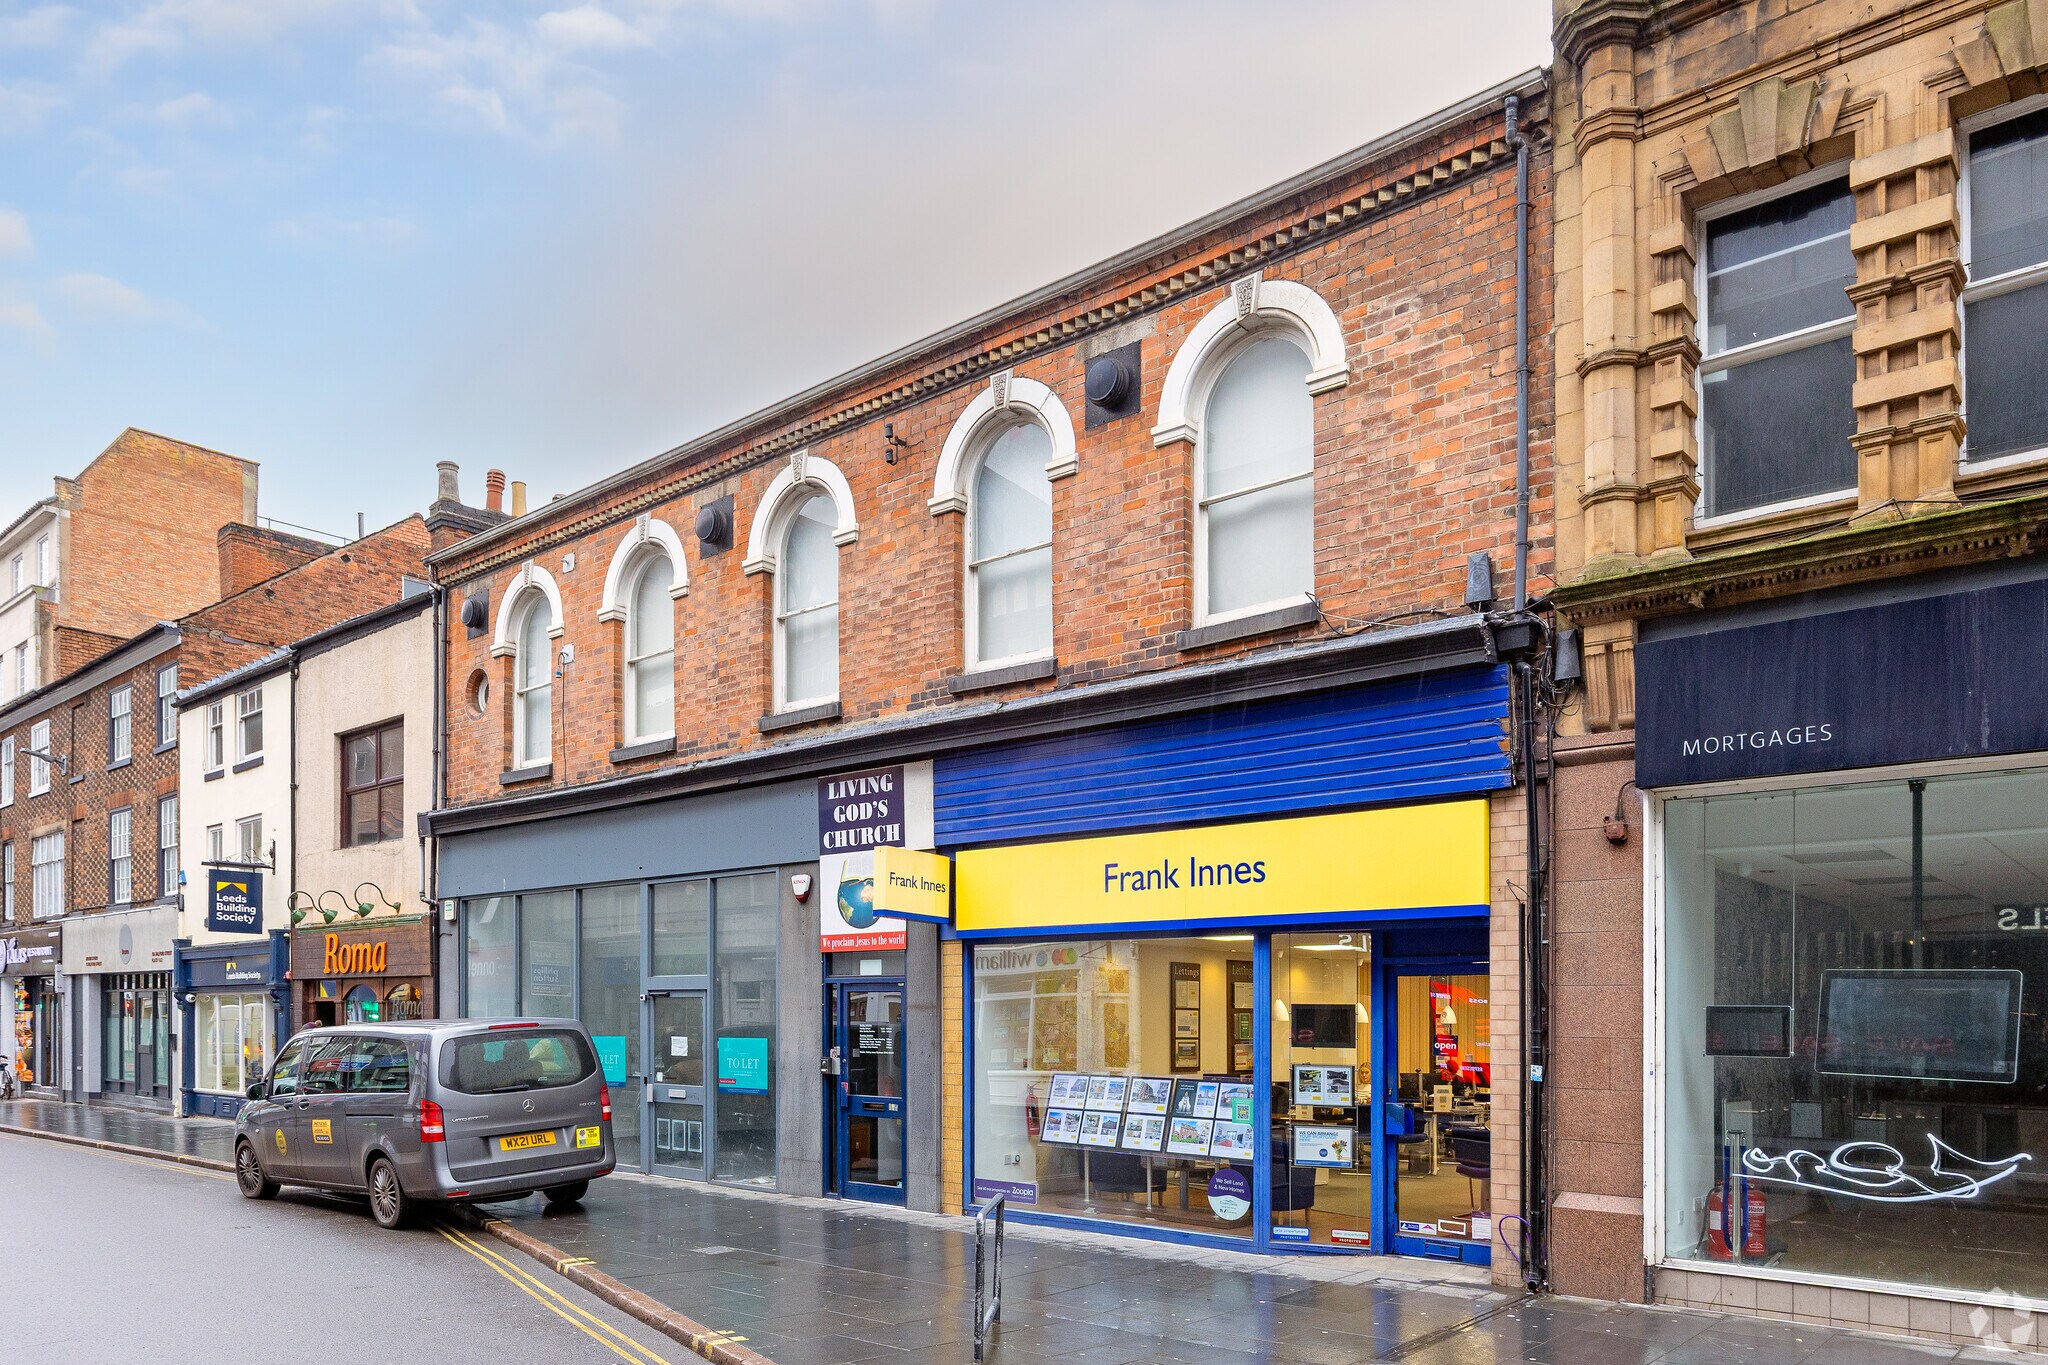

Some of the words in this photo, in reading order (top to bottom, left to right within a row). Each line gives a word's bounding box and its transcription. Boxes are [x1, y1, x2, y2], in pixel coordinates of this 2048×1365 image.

[1682, 723, 1832, 757] MORTGAGES
[827, 773, 894, 800] LIVING
[833, 799, 888, 824] GOD'S
[823, 823, 901, 849] CHURCH
[1104, 858, 1180, 893] Frank
[1190, 856, 1267, 887] Innes
[889, 871, 918, 889] Frank
[920, 876, 946, 893] Innes
[216, 892, 247, 904] Leeds
[216, 902, 257, 915] Building
[216, 911, 255, 924] Society
[822, 937, 830, 948] We
[832, 936, 854, 949] proclaim
[855, 936, 870, 947] Jesus
[871, 936, 878, 945] to
[878, 935, 887, 945] the
[888, 934, 905, 944] world
[323, 933, 388, 974] Roma
[1174, 965, 1200, 979] Lettings
[1232, 965, 1253, 978] Letting
[1434, 1042, 1457, 1050] open
[605, 1054, 620, 1065] LET
[726, 1057, 740, 1069] TO
[741, 1058, 760, 1069] LET
[506, 1136, 529, 1148] WX21
[531, 1133, 551, 1145] URL
[1012, 1186, 1034, 1196] Zoopla
